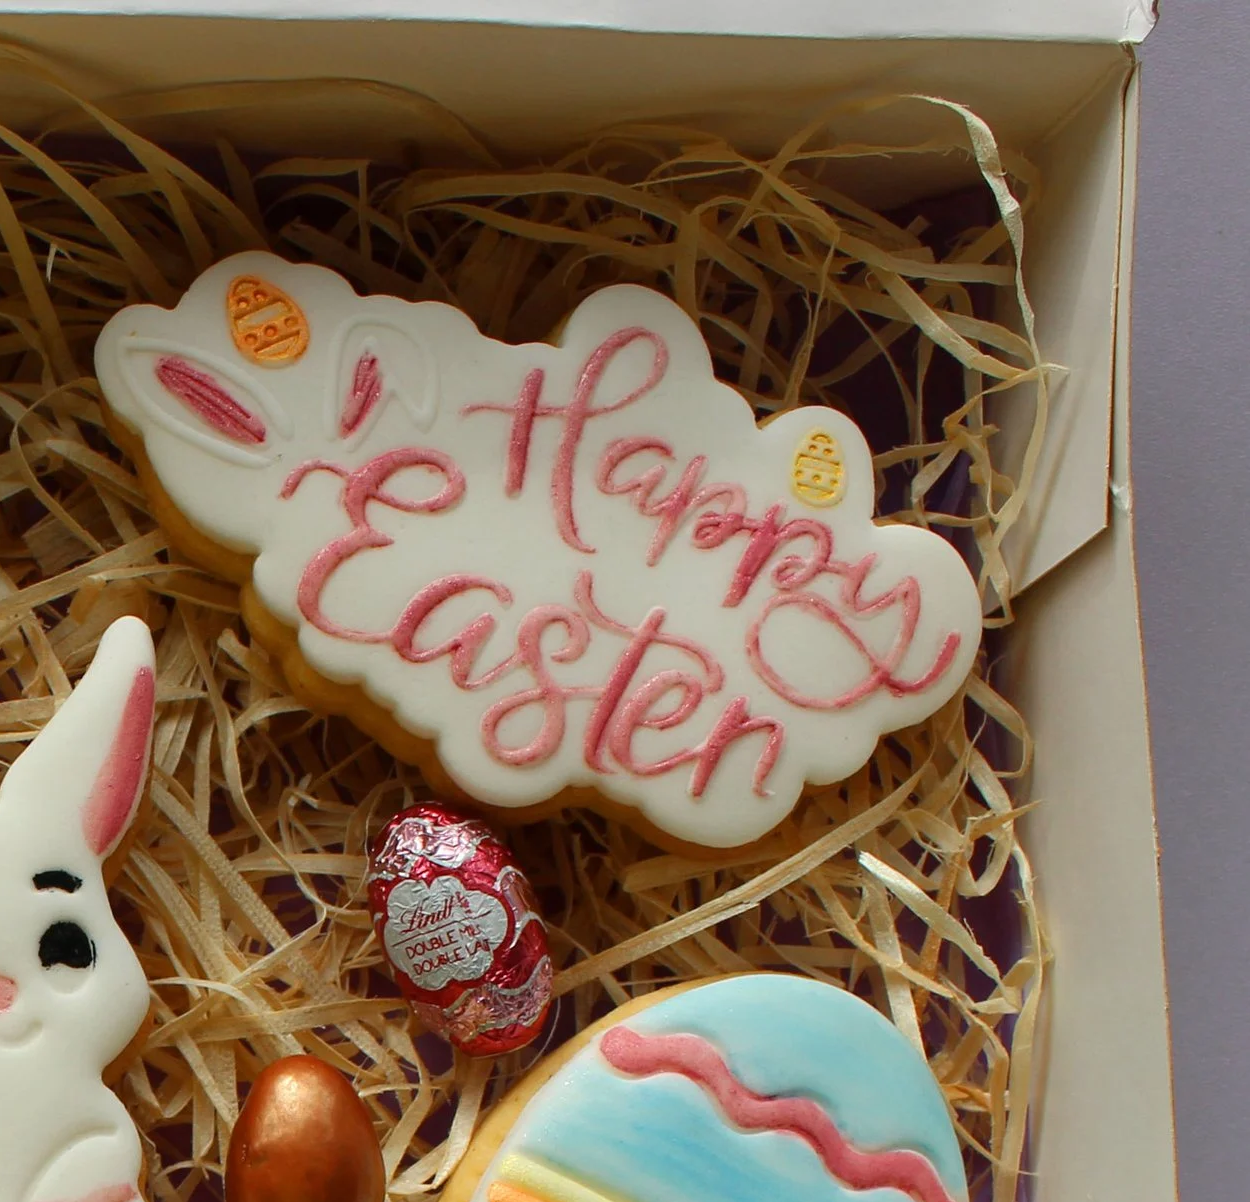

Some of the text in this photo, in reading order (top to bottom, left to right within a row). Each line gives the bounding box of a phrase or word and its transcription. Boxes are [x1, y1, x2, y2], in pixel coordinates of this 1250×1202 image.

[461, 326, 961, 711] Happy
[279, 447, 784, 800] Easter
[400, 895, 454, 935] Lindt
[405, 929, 459, 959] DOUBLE
[413, 946, 465, 975] DOUBLE
